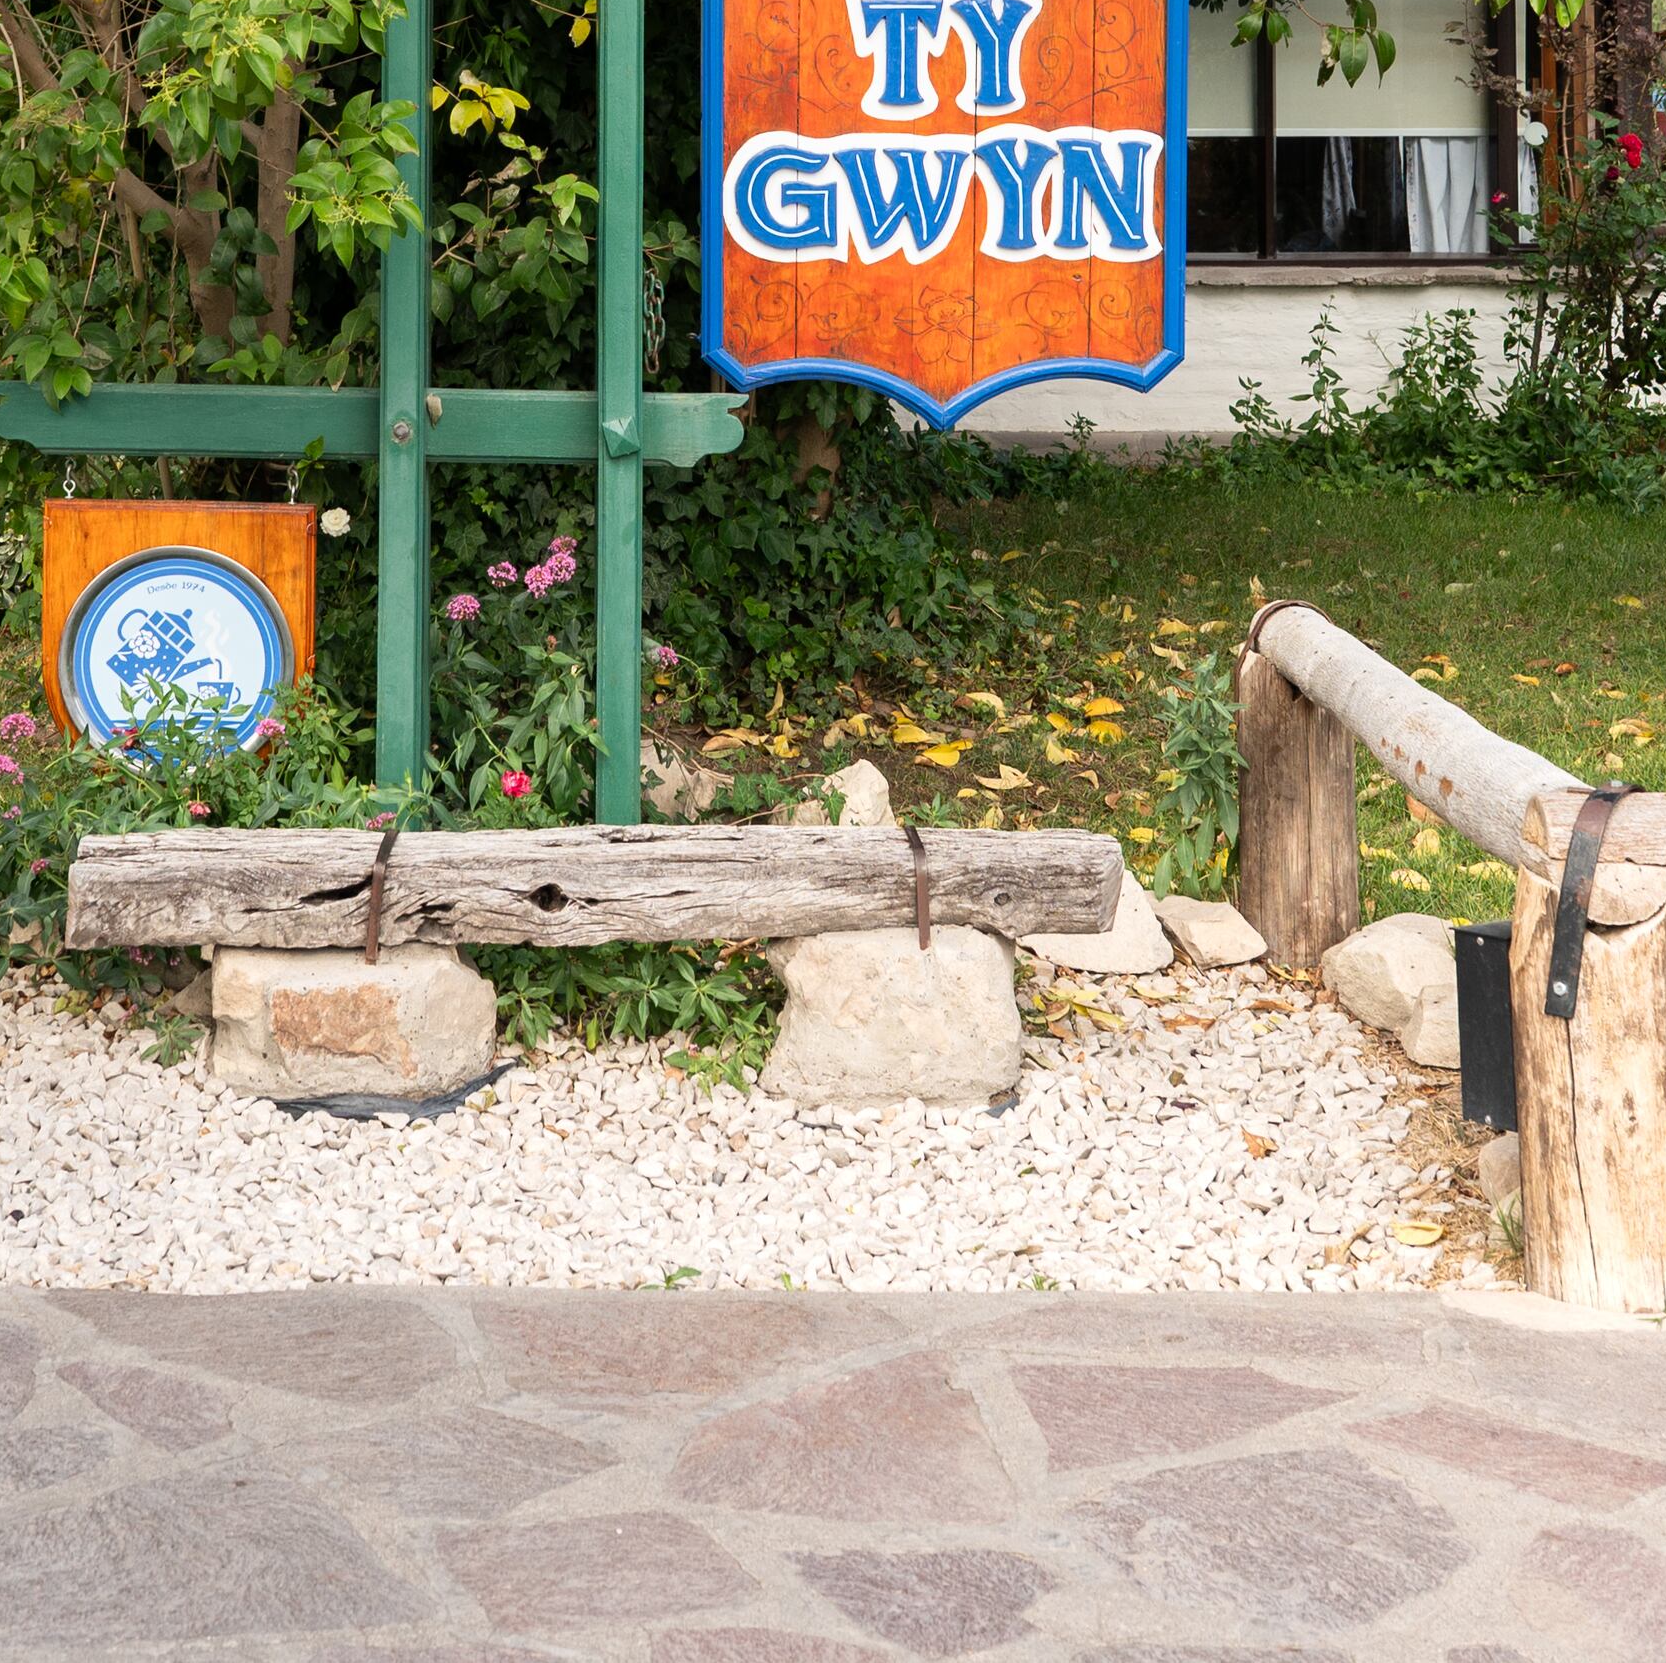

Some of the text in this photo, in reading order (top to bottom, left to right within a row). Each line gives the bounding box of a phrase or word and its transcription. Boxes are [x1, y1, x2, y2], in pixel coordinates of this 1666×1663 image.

[734, 138, 1152, 252] GWYN
[147, 581, 206, 595] Desde 1974
